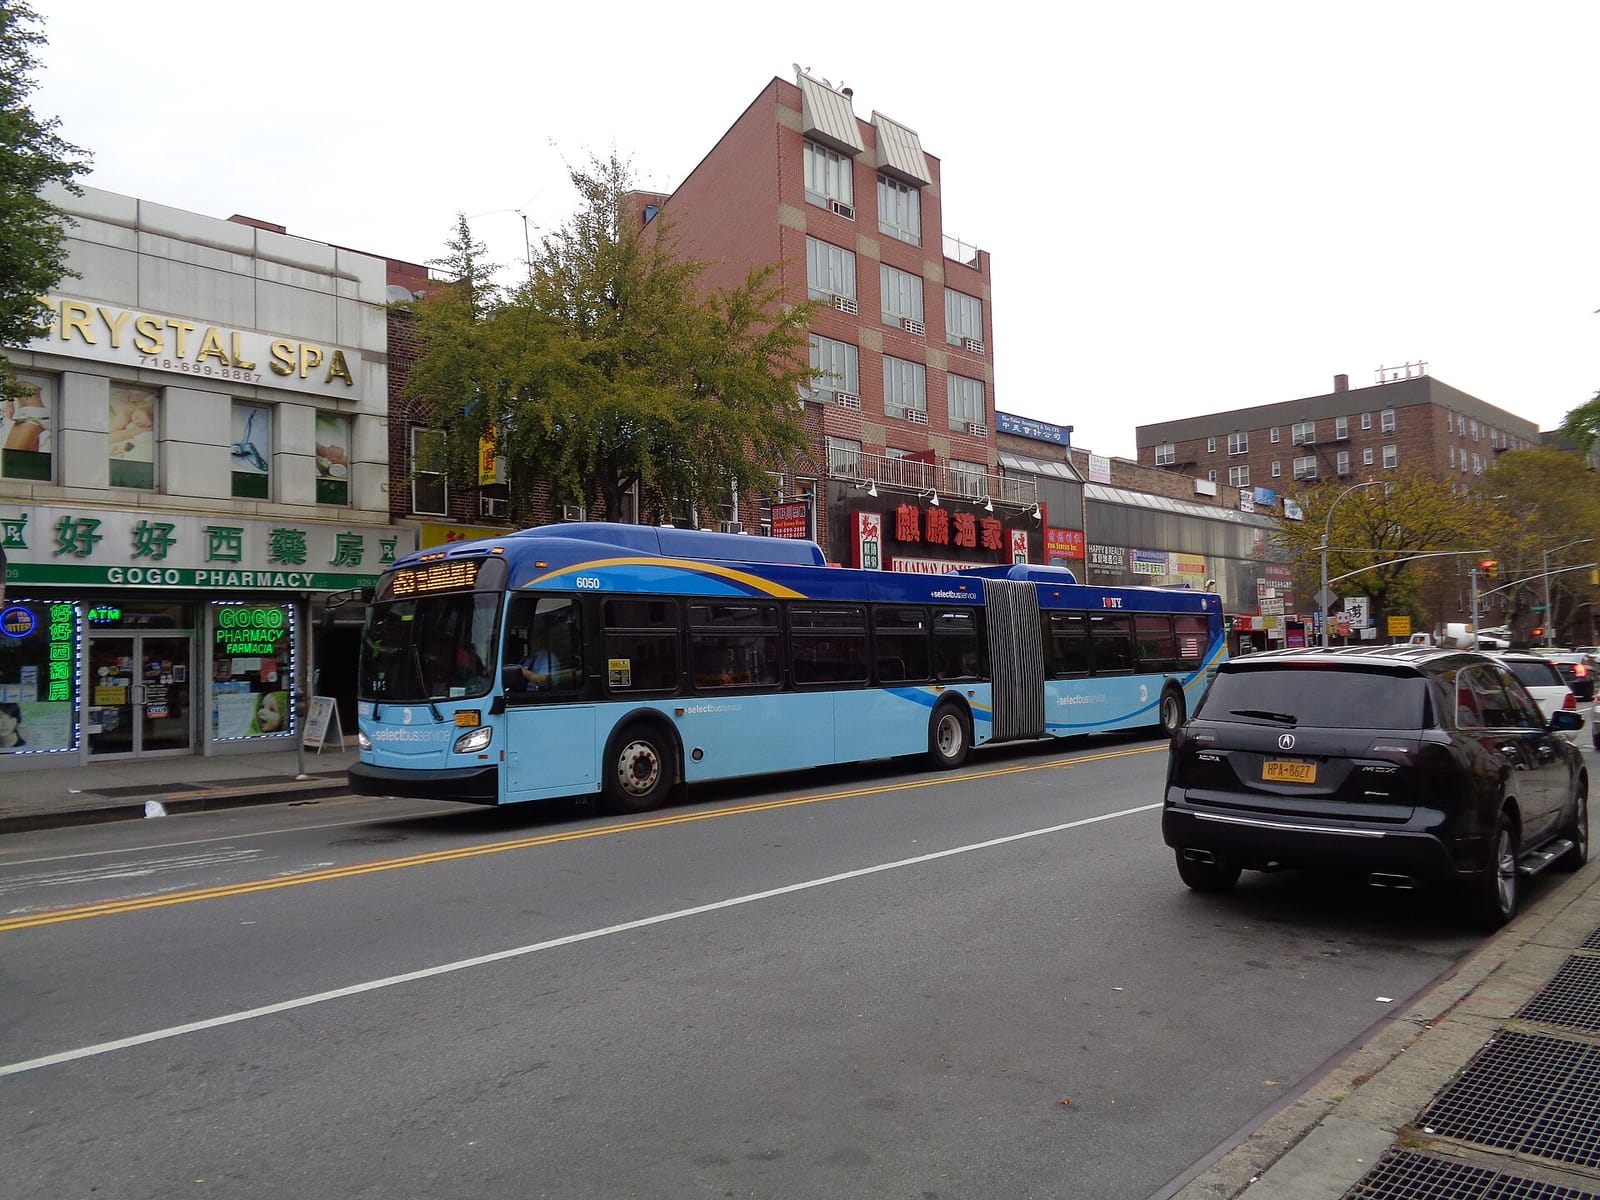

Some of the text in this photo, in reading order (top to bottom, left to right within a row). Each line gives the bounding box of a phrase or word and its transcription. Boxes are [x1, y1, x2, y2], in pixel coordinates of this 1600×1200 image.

[138, 354, 262, 384] 718-699-8887
[270, 339, 353, 386] SPA
[53, 515, 364, 567] 好好西藥房
[107, 567, 180, 585] GOGO
[195, 570, 315, 587] PHARMACY
[577, 577, 599, 589] 6050
[88, 609, 120, 620] ATM
[219, 608, 282, 628] GOGO
[217, 629, 283, 643] PHARMACY
[227, 643, 273, 654] FARMACIA
